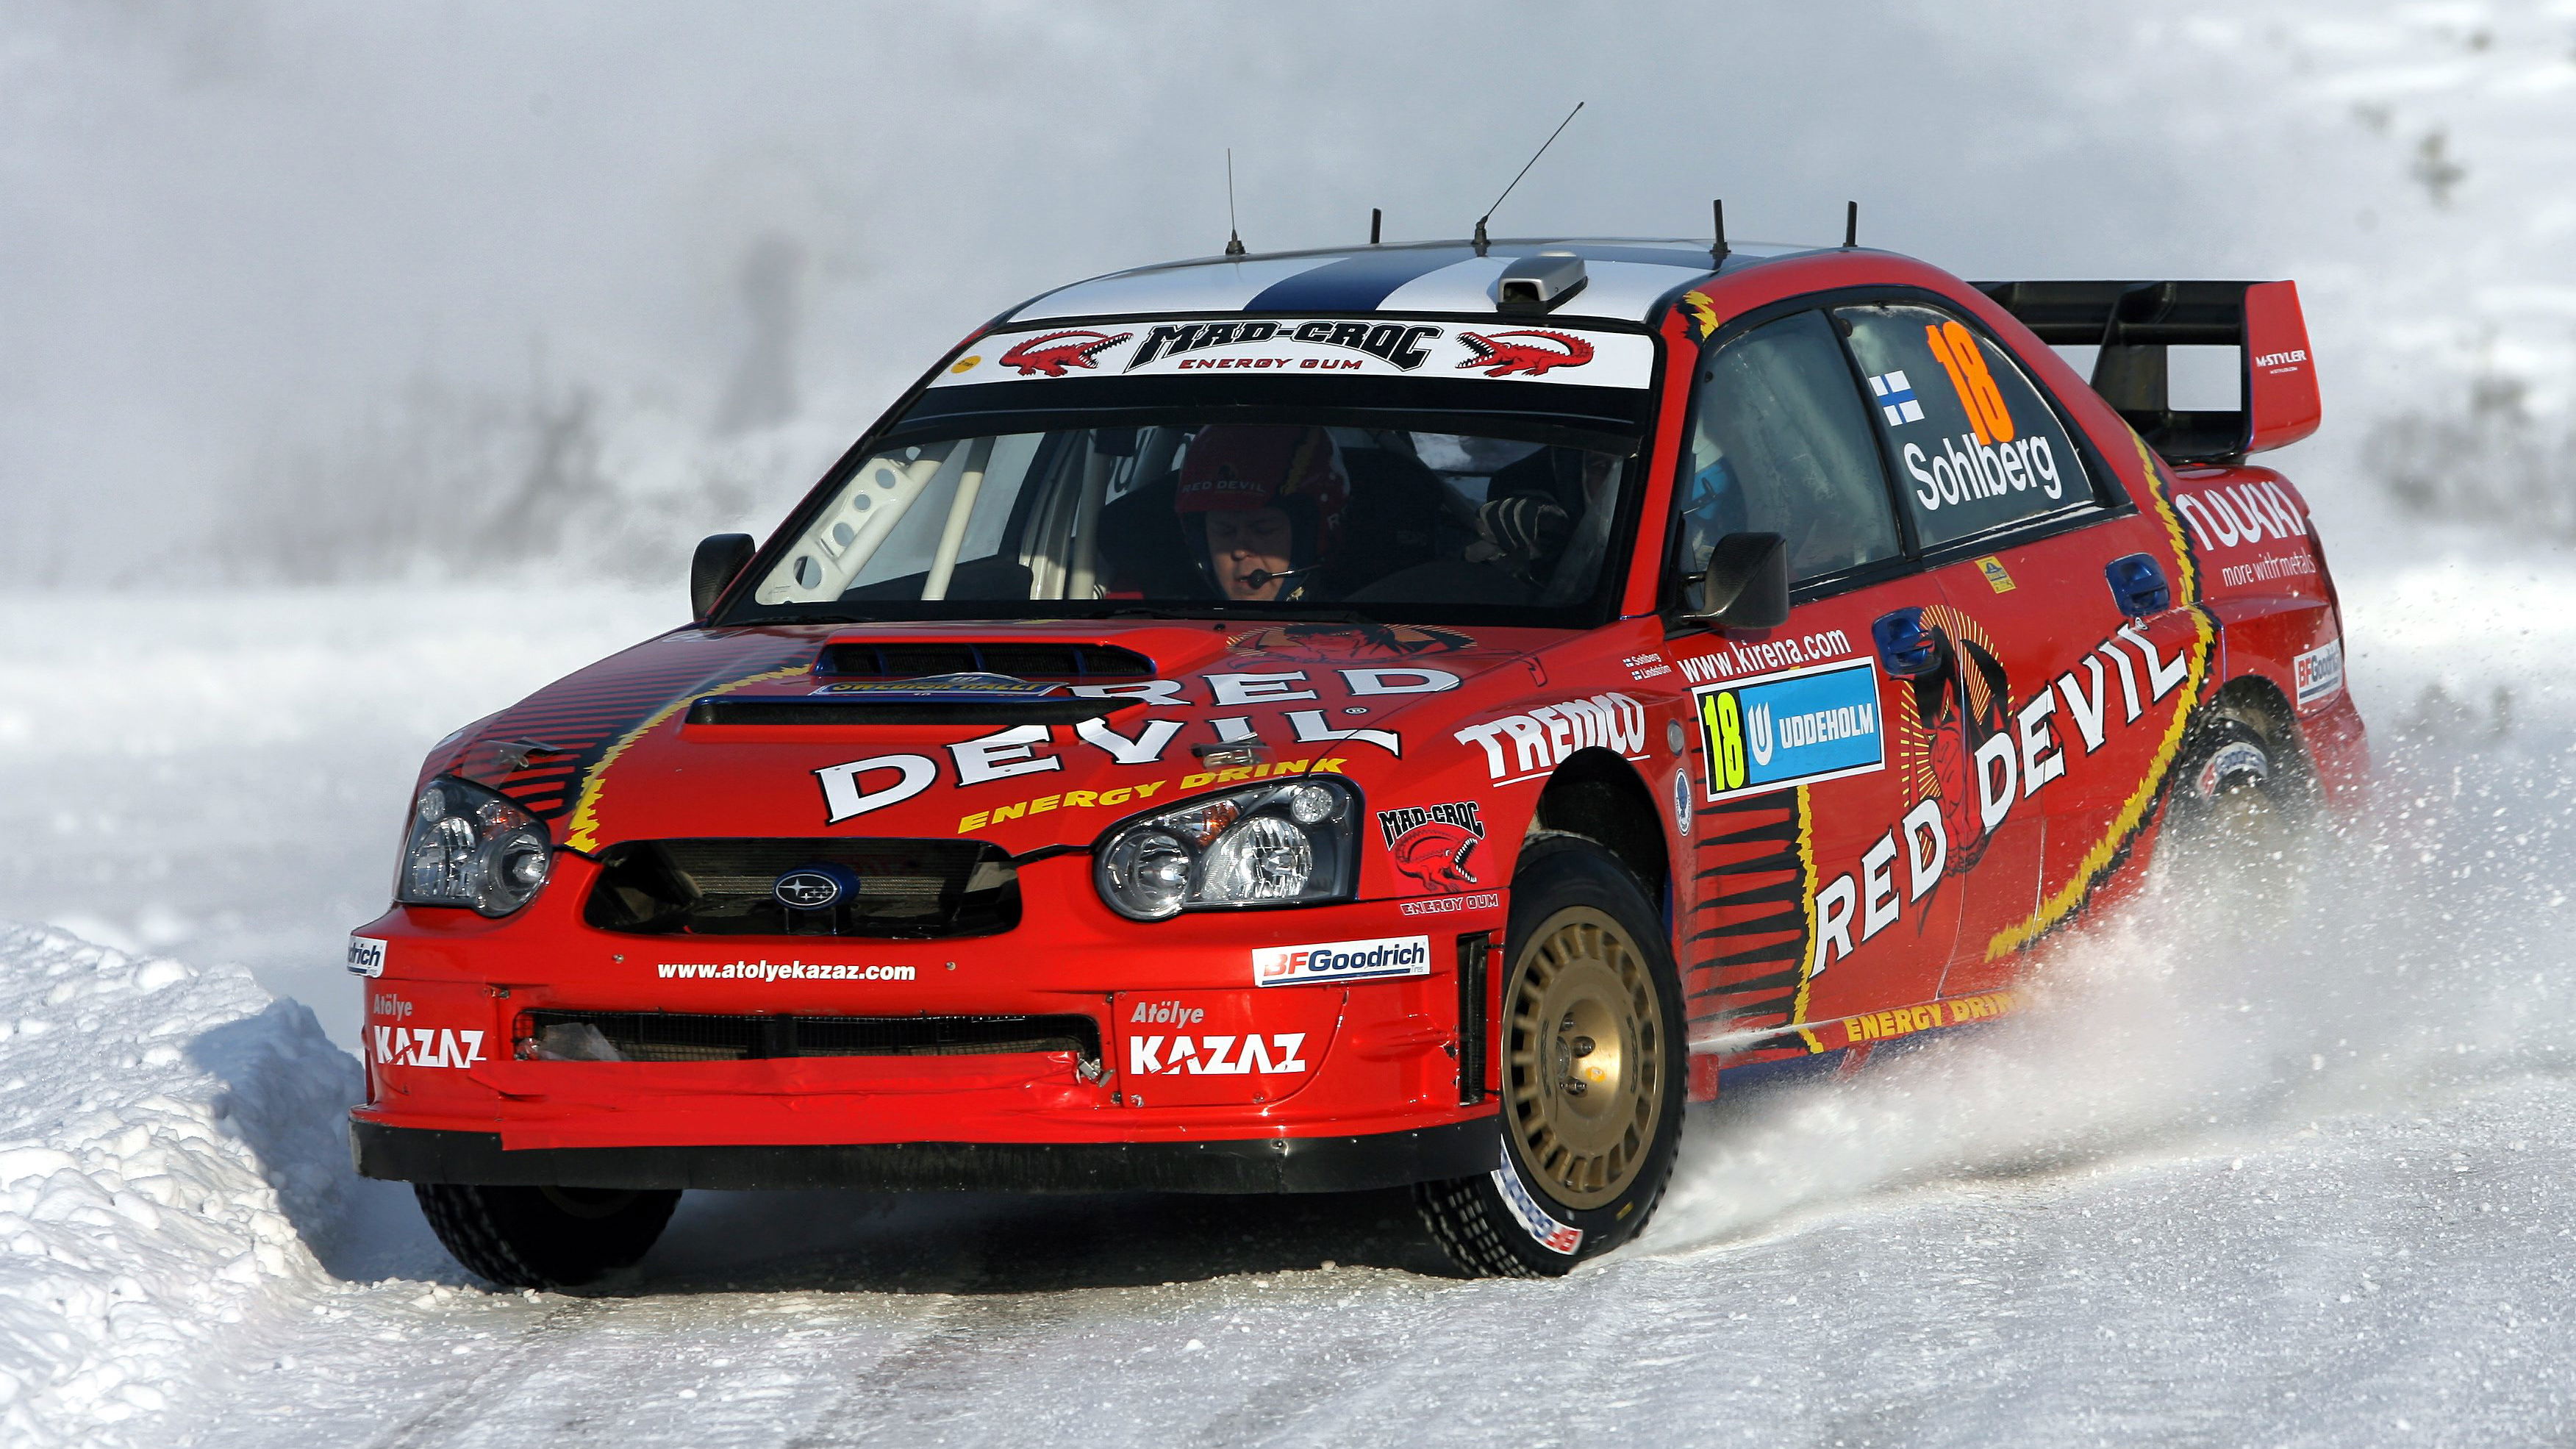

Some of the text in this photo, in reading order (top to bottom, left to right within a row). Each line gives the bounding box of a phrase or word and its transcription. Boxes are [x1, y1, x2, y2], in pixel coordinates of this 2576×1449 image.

[1123, 321, 1445, 373] MAD-CROC
[1178, 358, 1364, 369] ENERGY GUM
[1925, 318, 2014, 446] 18
[1182, 480, 1267, 493] RED DEVIL
[1904, 432, 2062, 510] Sohlberg
[2222, 547, 2316, 587] more with metals
[1677, 629, 1852, 683] www.kirena.com
[1067, 668, 1461, 706] RED
[1453, 692, 1645, 779] TREMCO
[1703, 692, 1745, 791] 18
[1779, 703, 1875, 749] UDDEHOLM
[815, 709, 1400, 825] DEVIL
[957, 757, 1348, 834] ENERGY DRINK
[1808, 623, 2189, 979] RED DEVIL
[1376, 800, 1486, 852] MAD-CROC
[1400, 893, 1499, 916] ENERGY GUM
[657, 959, 916, 983] www.atolyekazaz.com
[1263, 942, 1425, 977] BFGoodrich
[373, 993, 413, 1022] Atölye
[1130, 1001, 1205, 1029] Atölye
[1843, 992, 2027, 1043] ENERGY DRIN
[374, 1026, 487, 1069] KAZAZ
[1130, 1032, 1306, 1075] KAZAZ
